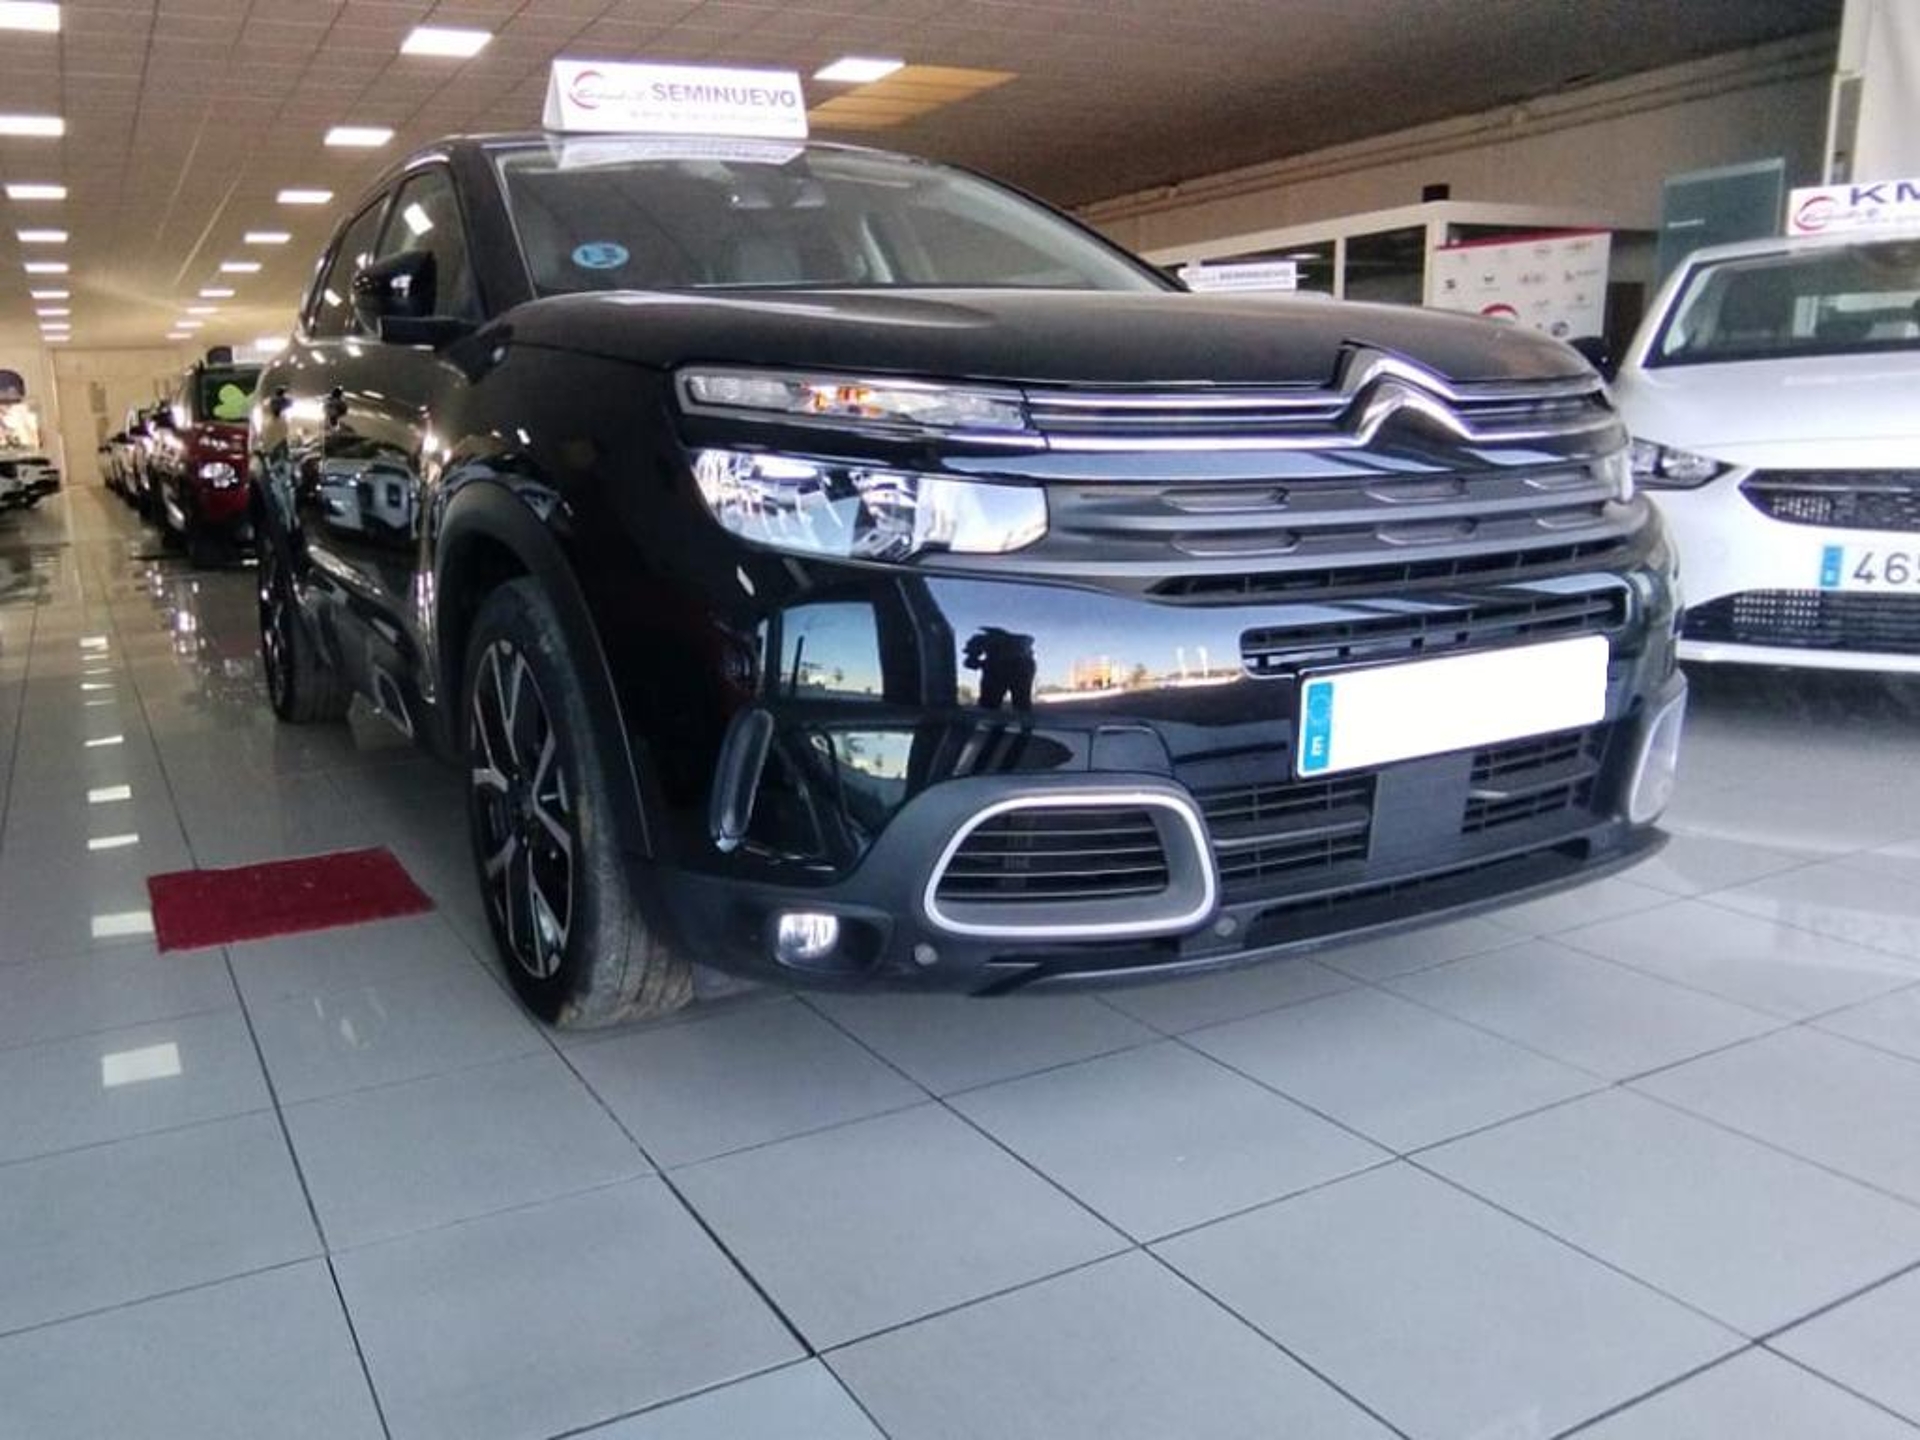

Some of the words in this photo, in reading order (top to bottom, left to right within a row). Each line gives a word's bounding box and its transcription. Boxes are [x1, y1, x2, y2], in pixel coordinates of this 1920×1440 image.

[650, 82, 797, 108] SEMINUEVO
[1852, 551, 1920, 584] 46
[1311, 736, 1324, 756] E
